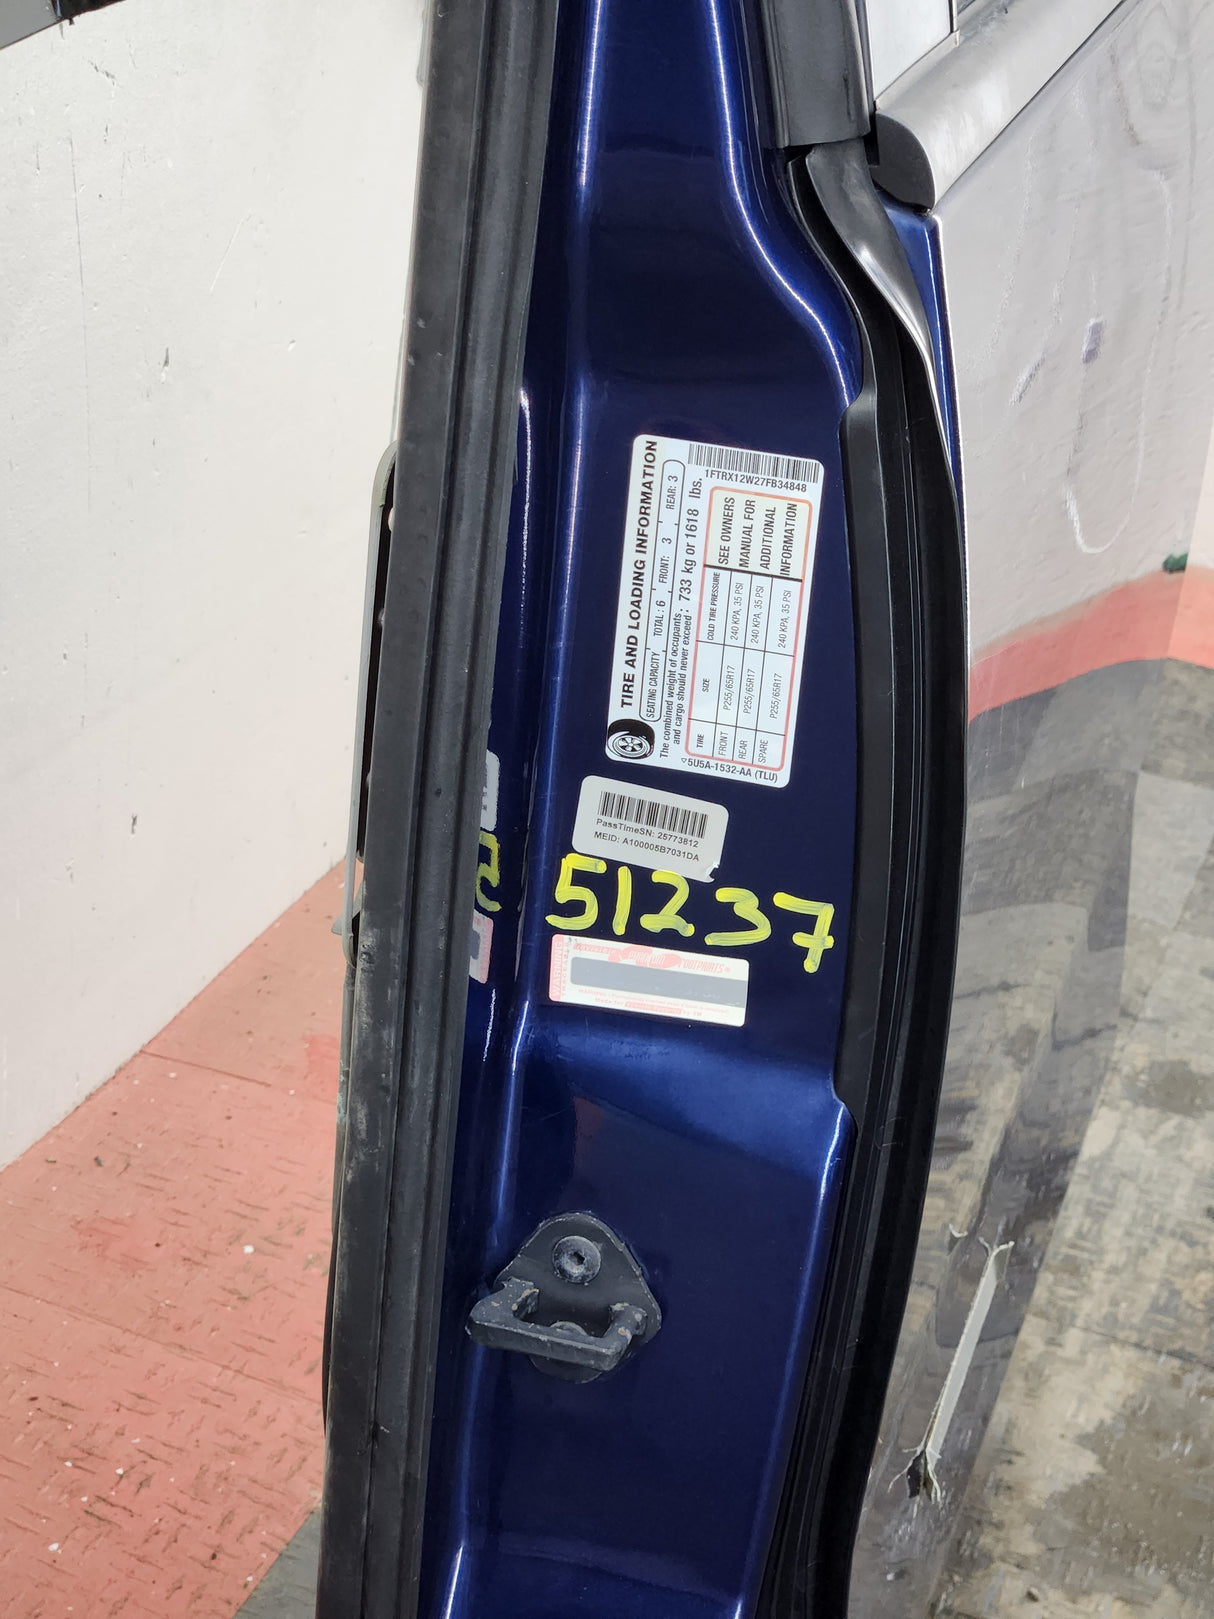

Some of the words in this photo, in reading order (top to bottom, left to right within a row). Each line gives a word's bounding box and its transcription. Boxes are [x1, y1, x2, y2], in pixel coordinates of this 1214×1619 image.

[688, 478, 702, 499] lbs.
[705, 470, 807, 493] 1FTRX12W27FB34848
[635, 440, 657, 554] INFORMATION
[665, 486, 677, 510] REAR:
[720, 497, 735, 542] OWNERS
[743, 499, 756, 521] FOR
[684, 508, 699, 539] 1618
[661, 537, 672, 545] 3
[685, 542, 695, 555] or
[738, 524, 753, 568] MANUAL
[759, 507, 776, 570] ADDITIONAL
[779, 503, 797, 576] INFORMATION
[681, 559, 697, 574] kg
[718, 545, 730, 565] SEE
[658, 555, 670, 584] FRONT:
[628, 559, 646, 630] LOADING
[678, 579, 692, 601] 733
[710, 572, 720, 606] PRESSURE
[734, 582, 744, 595] PSI
[755, 585, 764, 598] PSI
[782, 589, 792, 603] PSI
[733, 596, 743, 606] 35
[754, 599, 763, 609] 35
[781, 604, 790, 614] 35
[708, 607, 717, 622] TIRE
[731, 608, 742, 625] KPA,
[752, 612, 763, 628] KPA,
[779, 616, 790, 633] KPA,
[707, 623, 715, 641] COLD
[730, 626, 739, 641] 240
[750, 629, 760, 644] 240
[777, 633, 787, 649] 240
[625, 635, 638, 669] AND
[668, 658, 677, 668] of
[680, 647, 689, 671] never
[648, 651, 660, 687] CAPACITY
[621, 672, 635, 708] TIRE
[666, 670, 679, 698] weight
[676, 673, 686, 701] should
[702, 678, 710, 692] SIZE
[723, 665, 735, 711] P255/65R17
[743, 668, 755, 714] P255/65R17
[646, 689, 657, 718] SEATING
[769, 673, 782, 719] P255/65R17
[663, 700, 674, 741] combined
[675, 703, 685, 727] cargo
[673, 729, 681, 745] and
[696, 734, 704, 748] TIRE
[718, 731, 728, 756] FRONT
[659, 742, 669, 758] The
[738, 740, 748, 760] REAR
[758, 739, 768, 763] SPARE
[755, 769, 778, 784] (TLU)
[596, 818, 655, 838] PassTimeSN:
[657, 832, 699, 848] 25773812
[594, 831, 621, 844] MEID:
[622, 838, 700, 861] A100005B7031DA
[545, 852, 835, 974] 51237
[553, 941, 562, 997] WARNING
